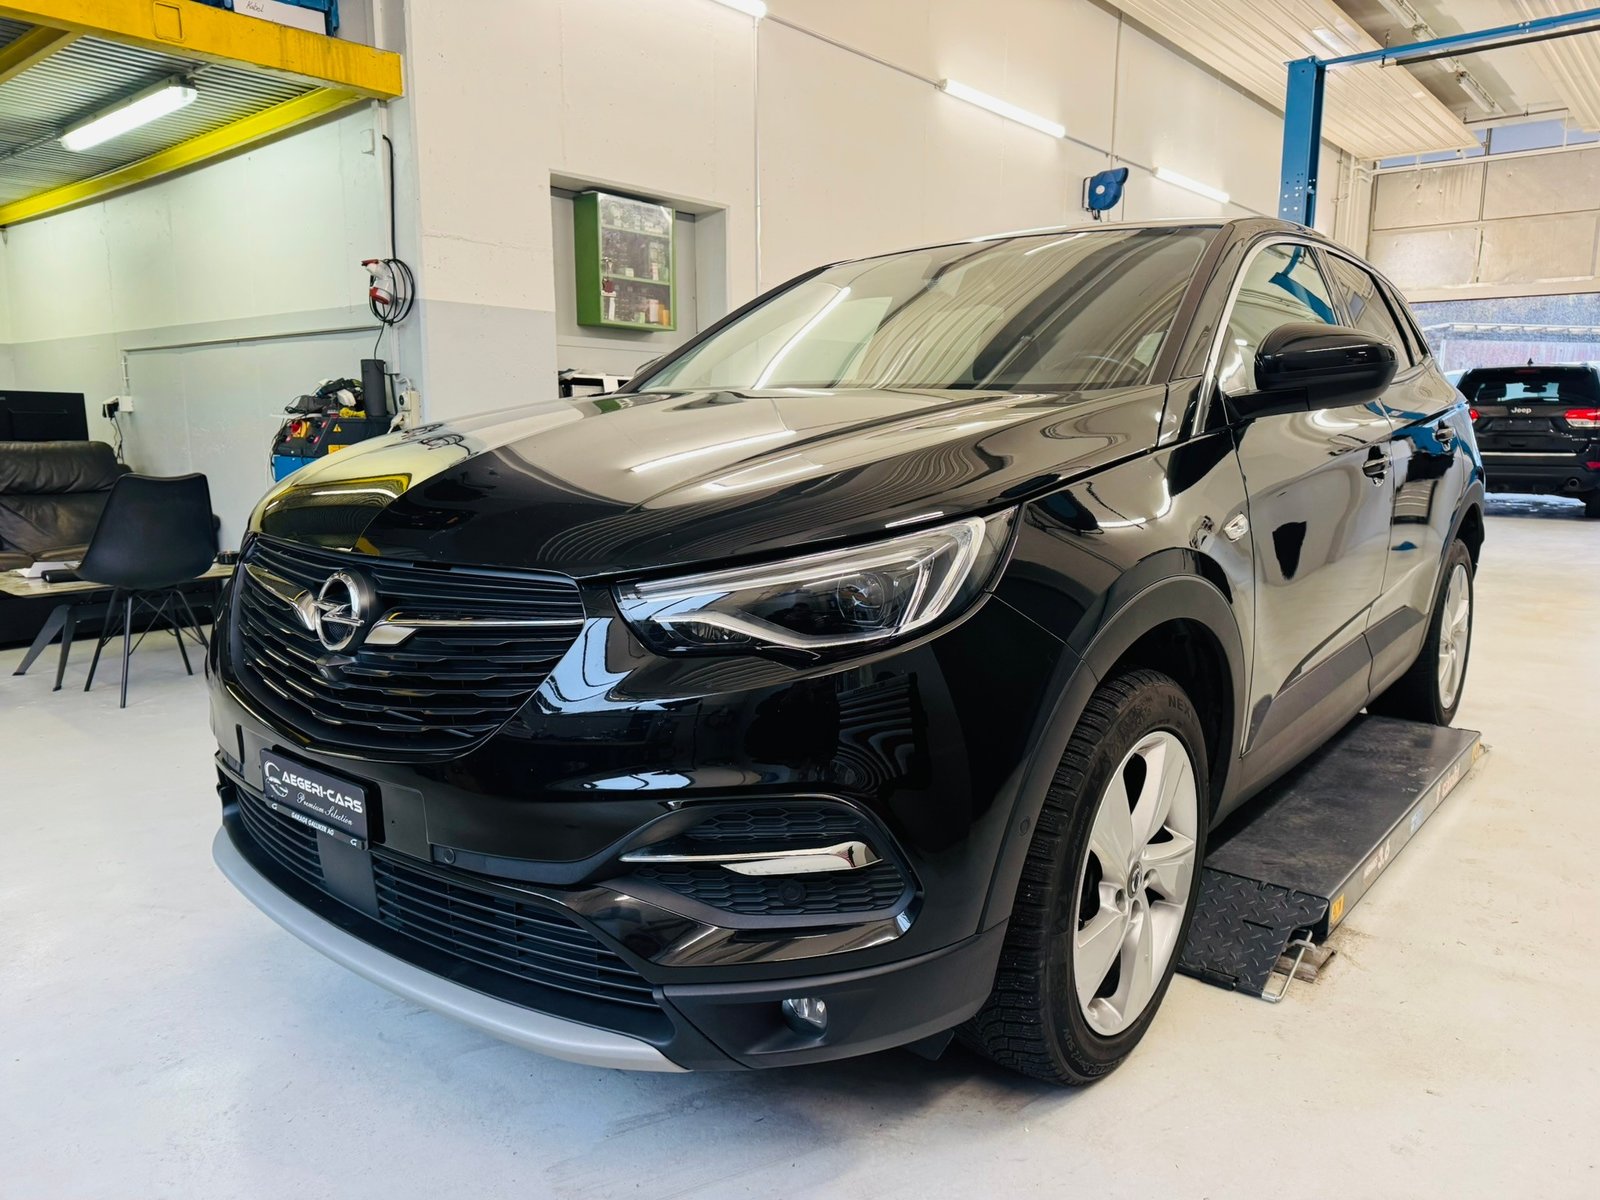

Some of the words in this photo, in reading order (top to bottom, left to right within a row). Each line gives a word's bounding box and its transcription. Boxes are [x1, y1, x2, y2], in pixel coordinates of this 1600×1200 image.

[282, 771, 363, 813] AEGERI-CARS
[297, 792, 325, 813] Premium
[325, 806, 353, 826] Selection
[291, 812, 308, 825] GARAGE
[327, 828, 335, 836] AG
